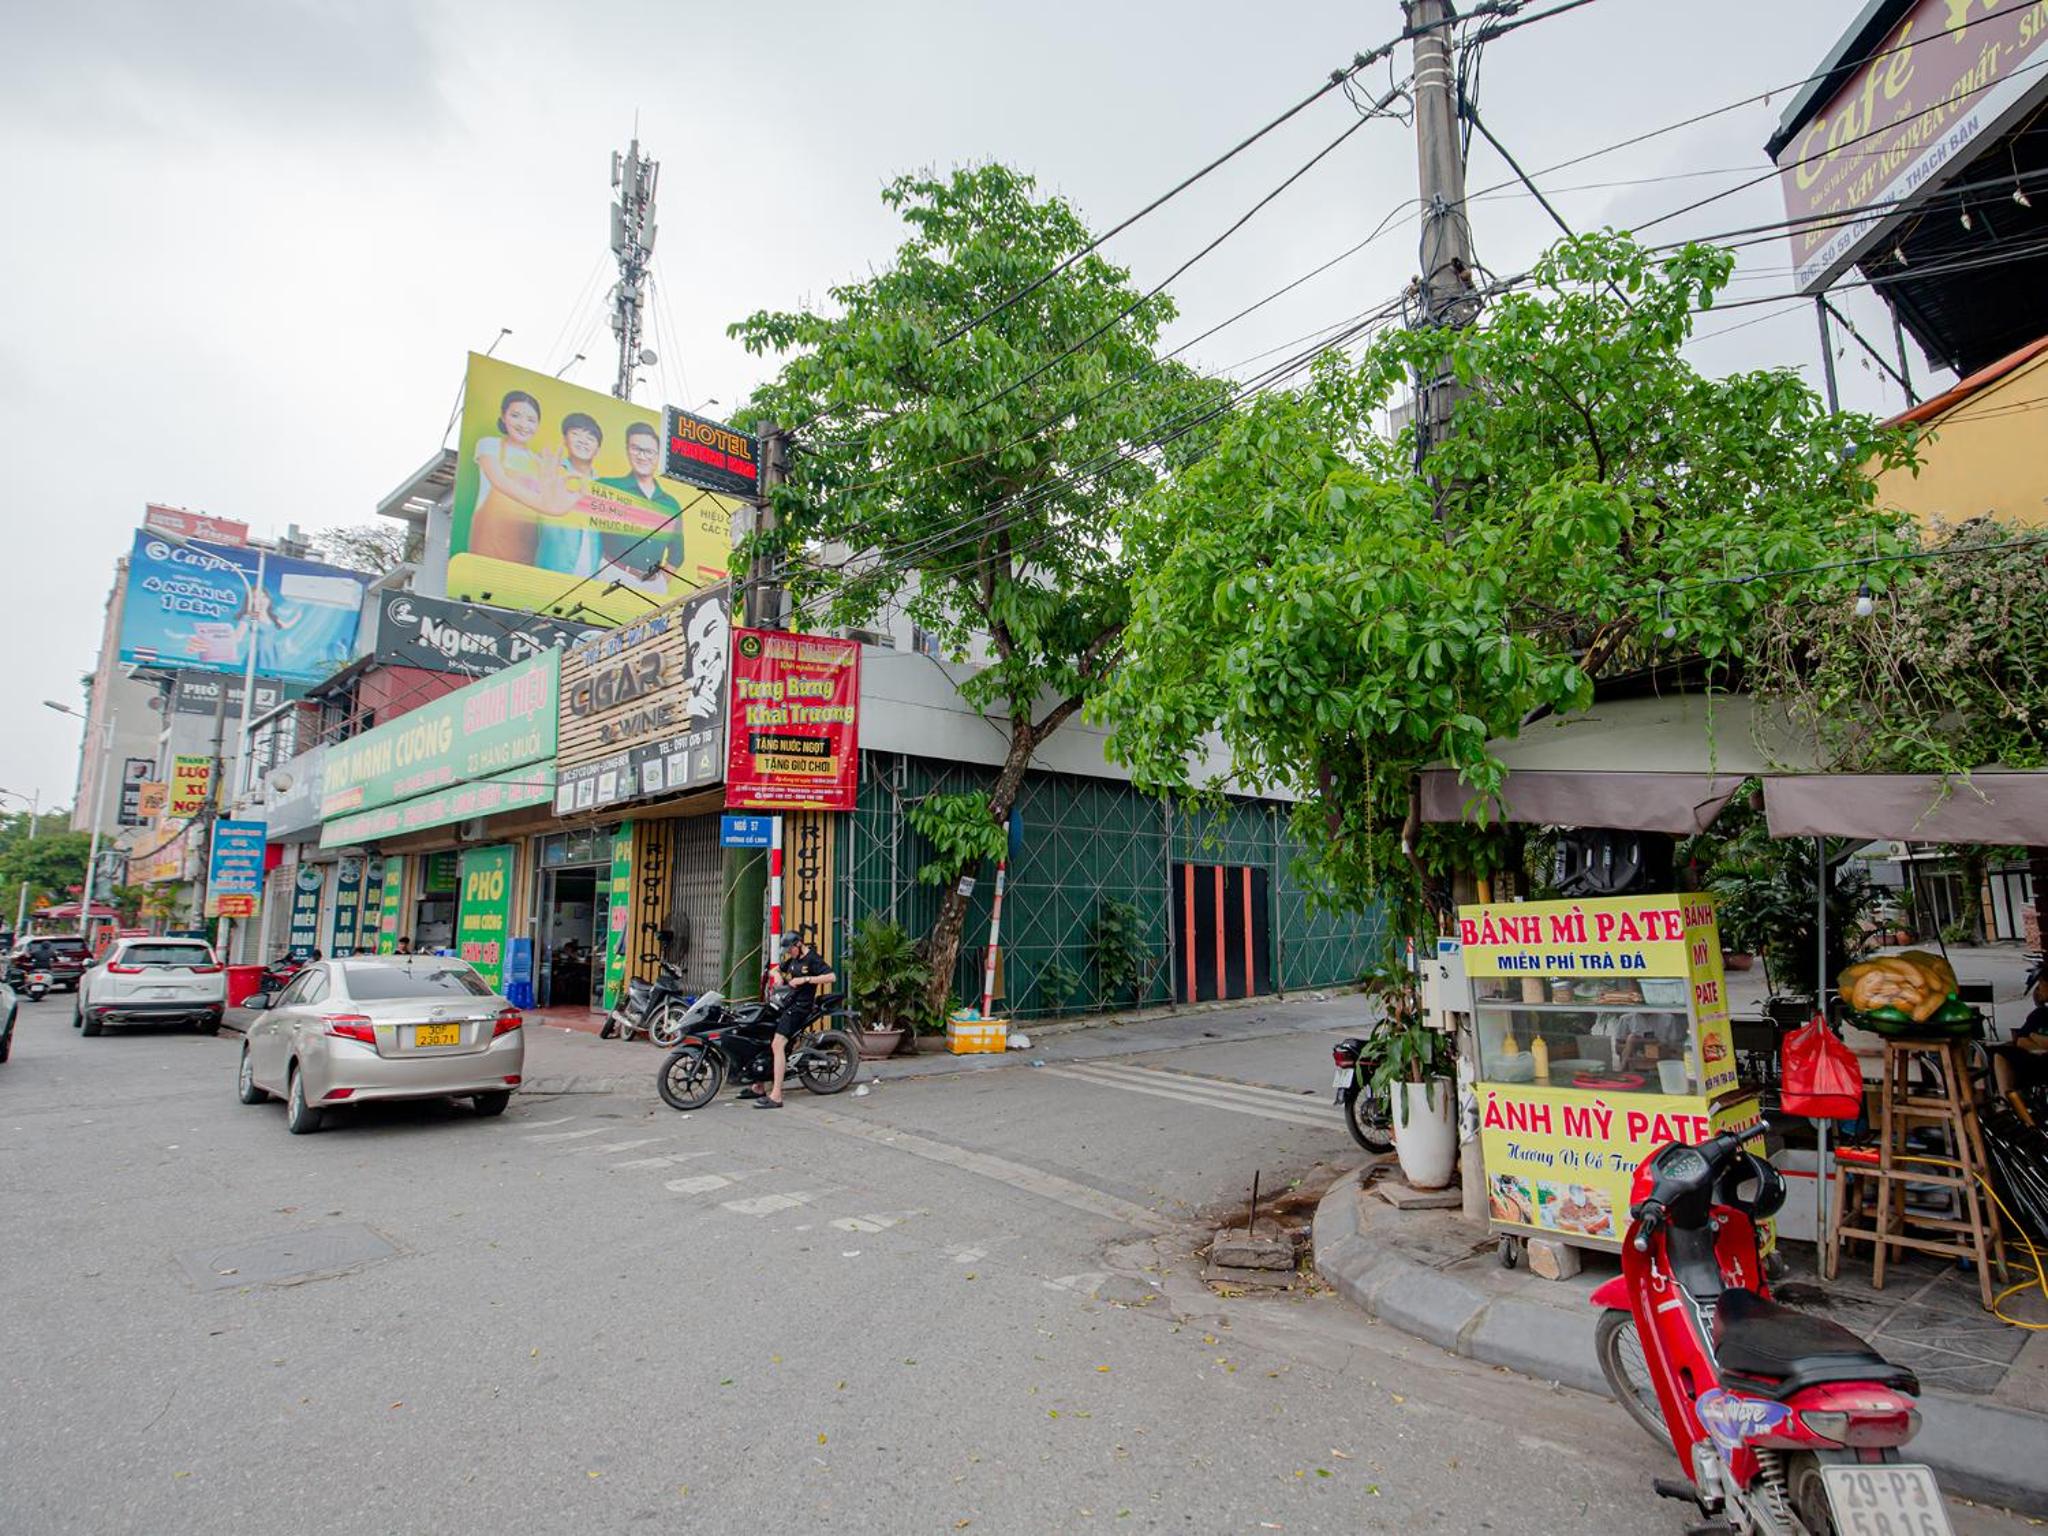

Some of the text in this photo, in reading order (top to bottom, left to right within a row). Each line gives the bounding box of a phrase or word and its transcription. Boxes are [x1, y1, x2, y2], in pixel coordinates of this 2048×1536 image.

[1796, 20, 1915, 191] Café
[1847, 160, 1878, 209] XAY
[1948, 41, 2000, 115] CHẤT
[679, 416, 752, 460] HOTEL
[171, 548, 243, 571] Casper
[142, 576, 161, 591] 4
[418, 616, 499, 658] Ngan
[570, 651, 665, 719] CIGAR
[736, 674, 834, 702] Tưng Bừng
[620, 702, 673, 739] WINE
[746, 702, 788, 726] Khai
[765, 758, 789, 771] TẶNG
[467, 858, 504, 902] PHỞ
[1550, 906, 1589, 945] MÌ
[1594, 910, 1685, 943] PATE
[1684, 900, 1714, 928] BÁNH
[1546, 951, 1576, 970] PHÍ
[1580, 950, 1616, 969] TRÀ
[1620, 950, 1647, 970] ĐÁ
[1692, 938, 1709, 966] MỲ
[1695, 981, 1718, 1005] PATE
[1562, 1099, 1613, 1141] MỲ
[1506, 1142, 1554, 1167] Hương
[1560, 1148, 1579, 1170] Vị
[1584, 1151, 1603, 1169] Cổ
[1729, 1399, 1767, 1422] Wave
[1840, 1472, 1930, 1509] 29-P3
